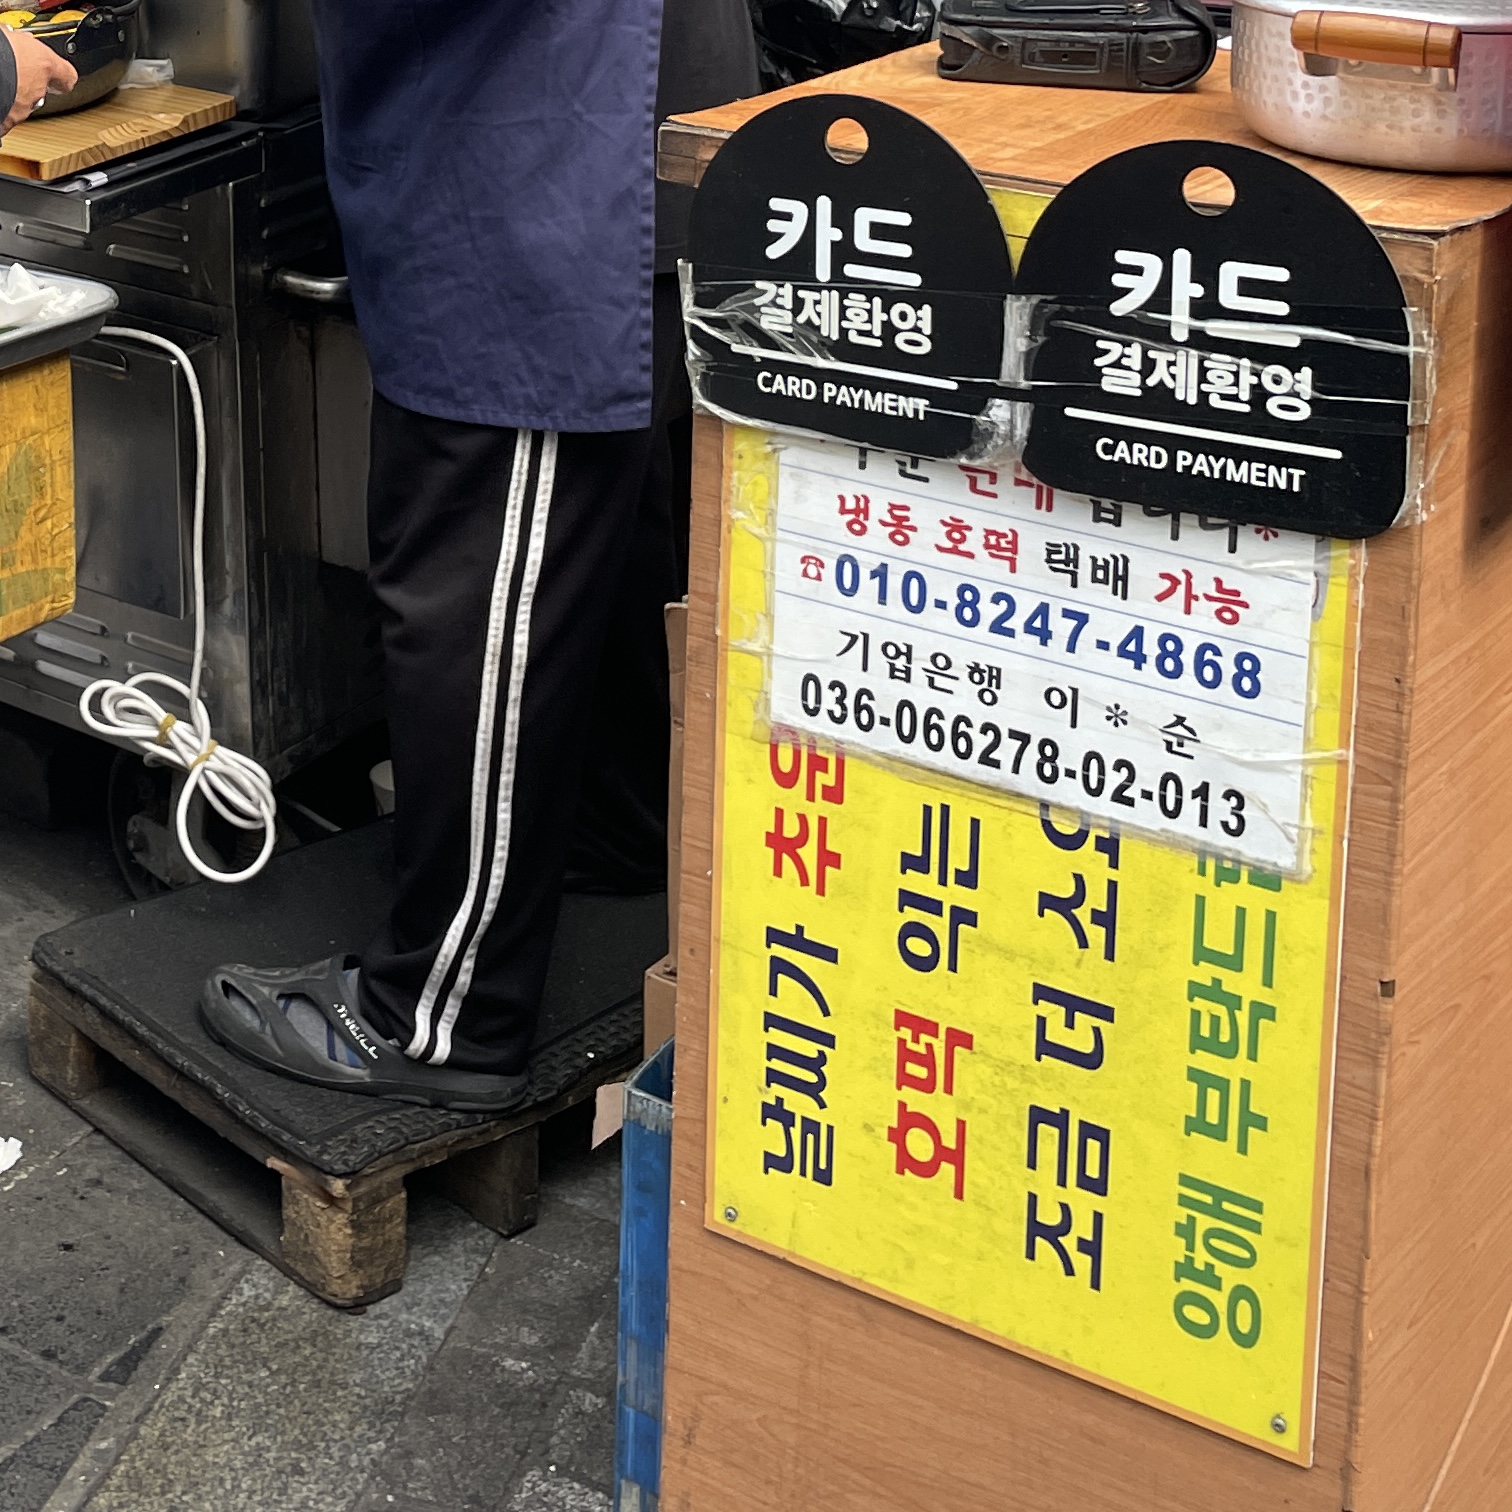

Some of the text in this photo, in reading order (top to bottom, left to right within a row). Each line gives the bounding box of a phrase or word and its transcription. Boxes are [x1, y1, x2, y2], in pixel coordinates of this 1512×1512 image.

[765, 195, 923, 287] 카드
[754, 281, 933, 356] 결제환영
[1109, 247, 1302, 348] 카드
[756, 371, 930, 421] CARD PAYMENT
[1093, 340, 1313, 422] 결제환영
[1095, 437, 1307, 493] CARD PAYMENT
[837, 494, 918, 547] 냉동
[934, 515, 1020, 574] 호떡
[1044, 541, 1131, 601] 택배
[1154, 569, 1251, 625] 가능
[835, 553, 1262, 701] 010-8247-4868
[836, 629, 1003, 707] 기업은행
[1044, 685, 1080, 729] 이
[800, 672, 1248, 839] 036-066278-02-013
[887, 803, 981, 1202] 호떡 익는
[1032, 982, 1115, 1071] 더
[761, 924, 839, 1187] 날씨가
[1025, 1104, 1111, 1293] 조금
[1173, 1173, 1264, 1350] 양해
